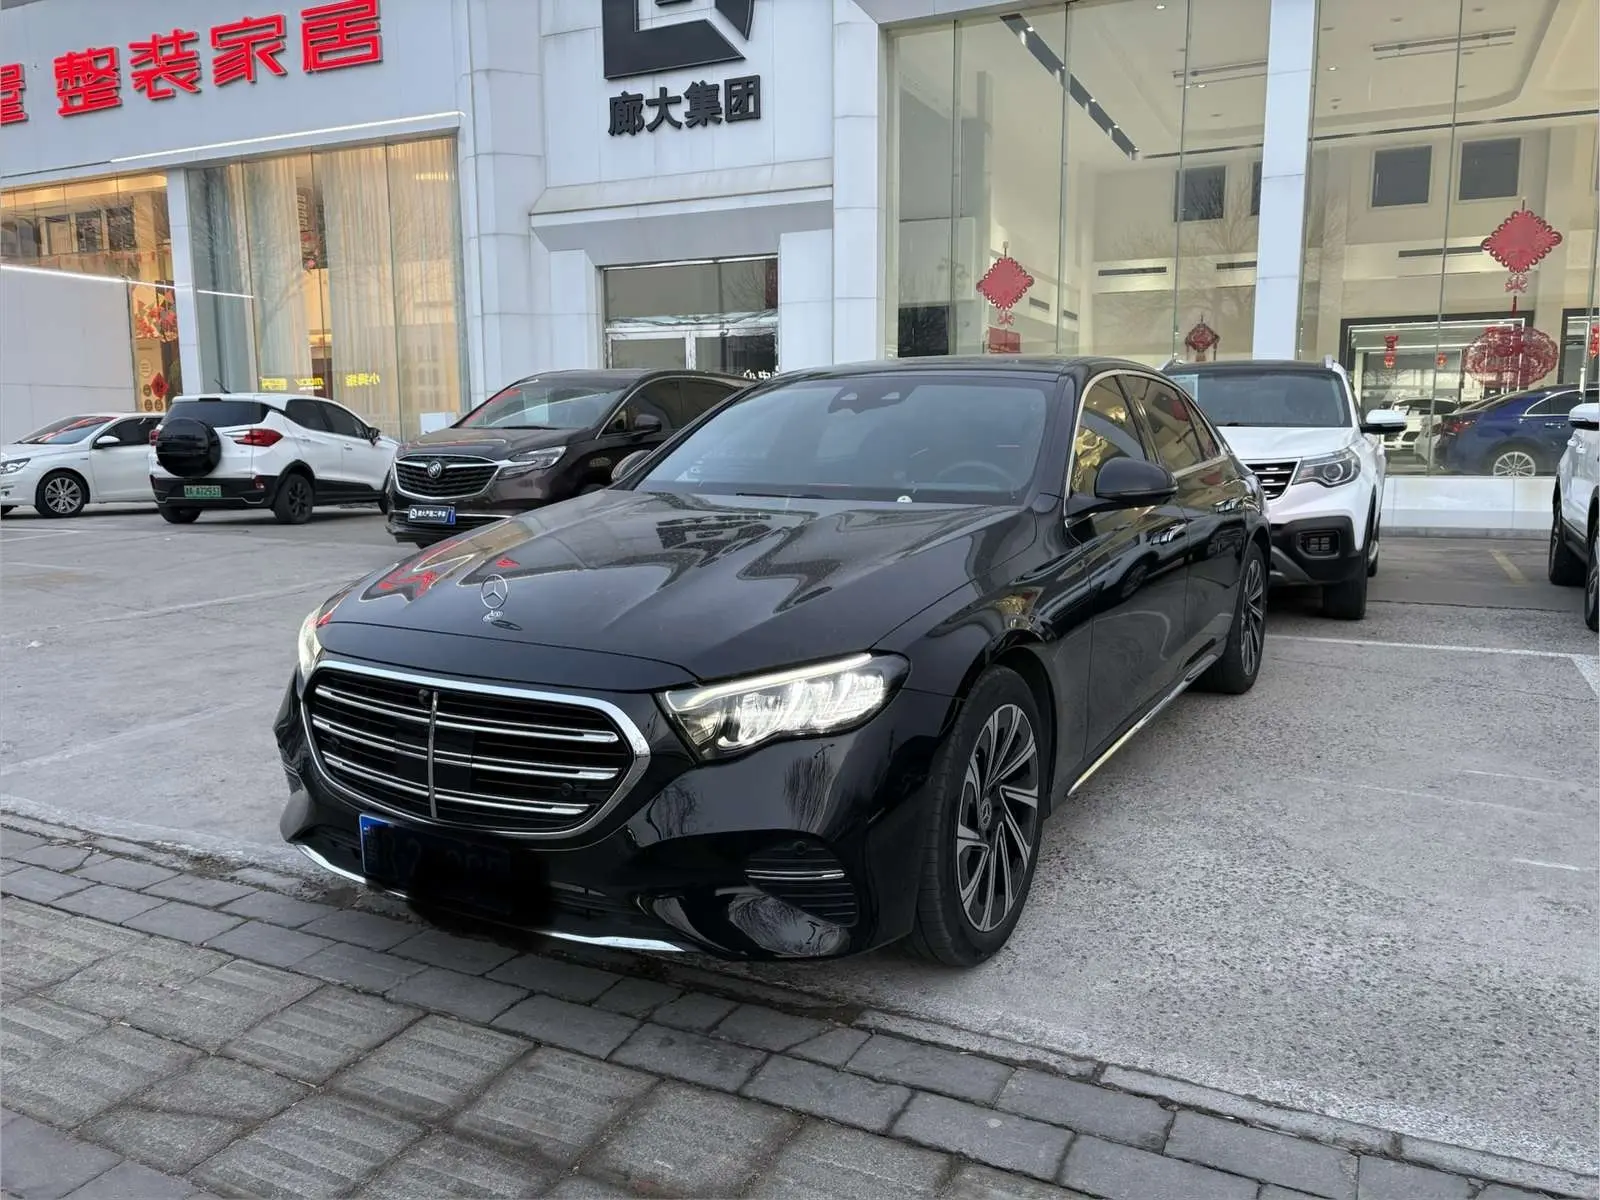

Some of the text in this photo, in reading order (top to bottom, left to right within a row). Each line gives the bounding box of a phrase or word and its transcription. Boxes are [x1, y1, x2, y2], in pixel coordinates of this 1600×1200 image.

[53, 0, 384, 118] 整装家居
[608, 74, 761, 137] 廊大集团
